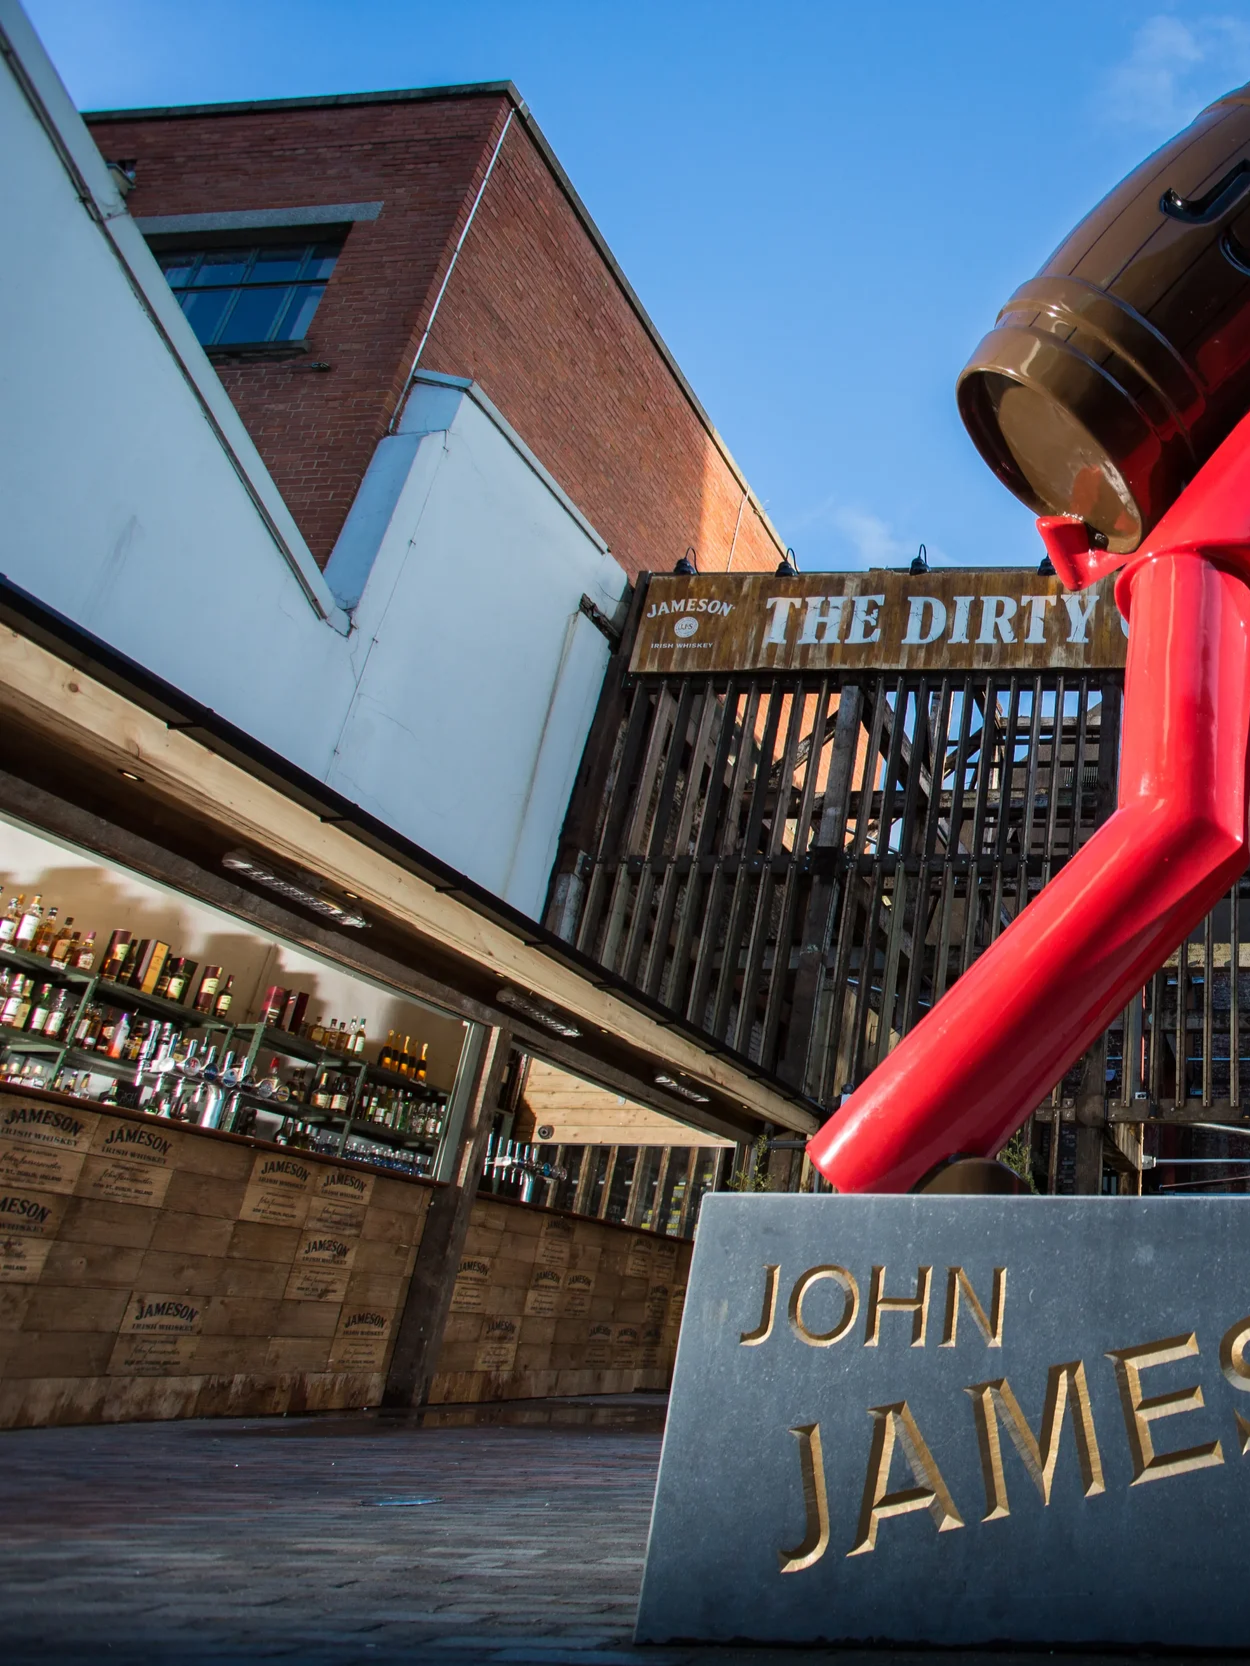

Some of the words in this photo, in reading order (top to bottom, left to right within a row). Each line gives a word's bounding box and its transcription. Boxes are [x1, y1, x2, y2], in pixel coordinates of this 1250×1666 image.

[647, 598, 733, 618] JAMESON
[766, 594, 885, 644] THE
[901, 594, 1099, 644] DIRTY
[4, 1107, 85, 1137] JAMESON
[0, 1128, 32, 1139] IRISH
[34, 1132, 79, 1147] WHISKEY
[105, 1127, 172, 1156] JAMESON
[101, 1146, 128, 1157] IRISH
[129, 1151, 167, 1165] WHISKEY
[261, 1161, 311, 1182] JAMESON
[323, 1174, 367, 1193] JAMESON
[305, 1239, 350, 1258] JAMESON
[135, 1301, 198, 1323] JAMESON
[739, 1264, 1008, 1349] JOHN
[344, 1312, 387, 1329] JAMESON
